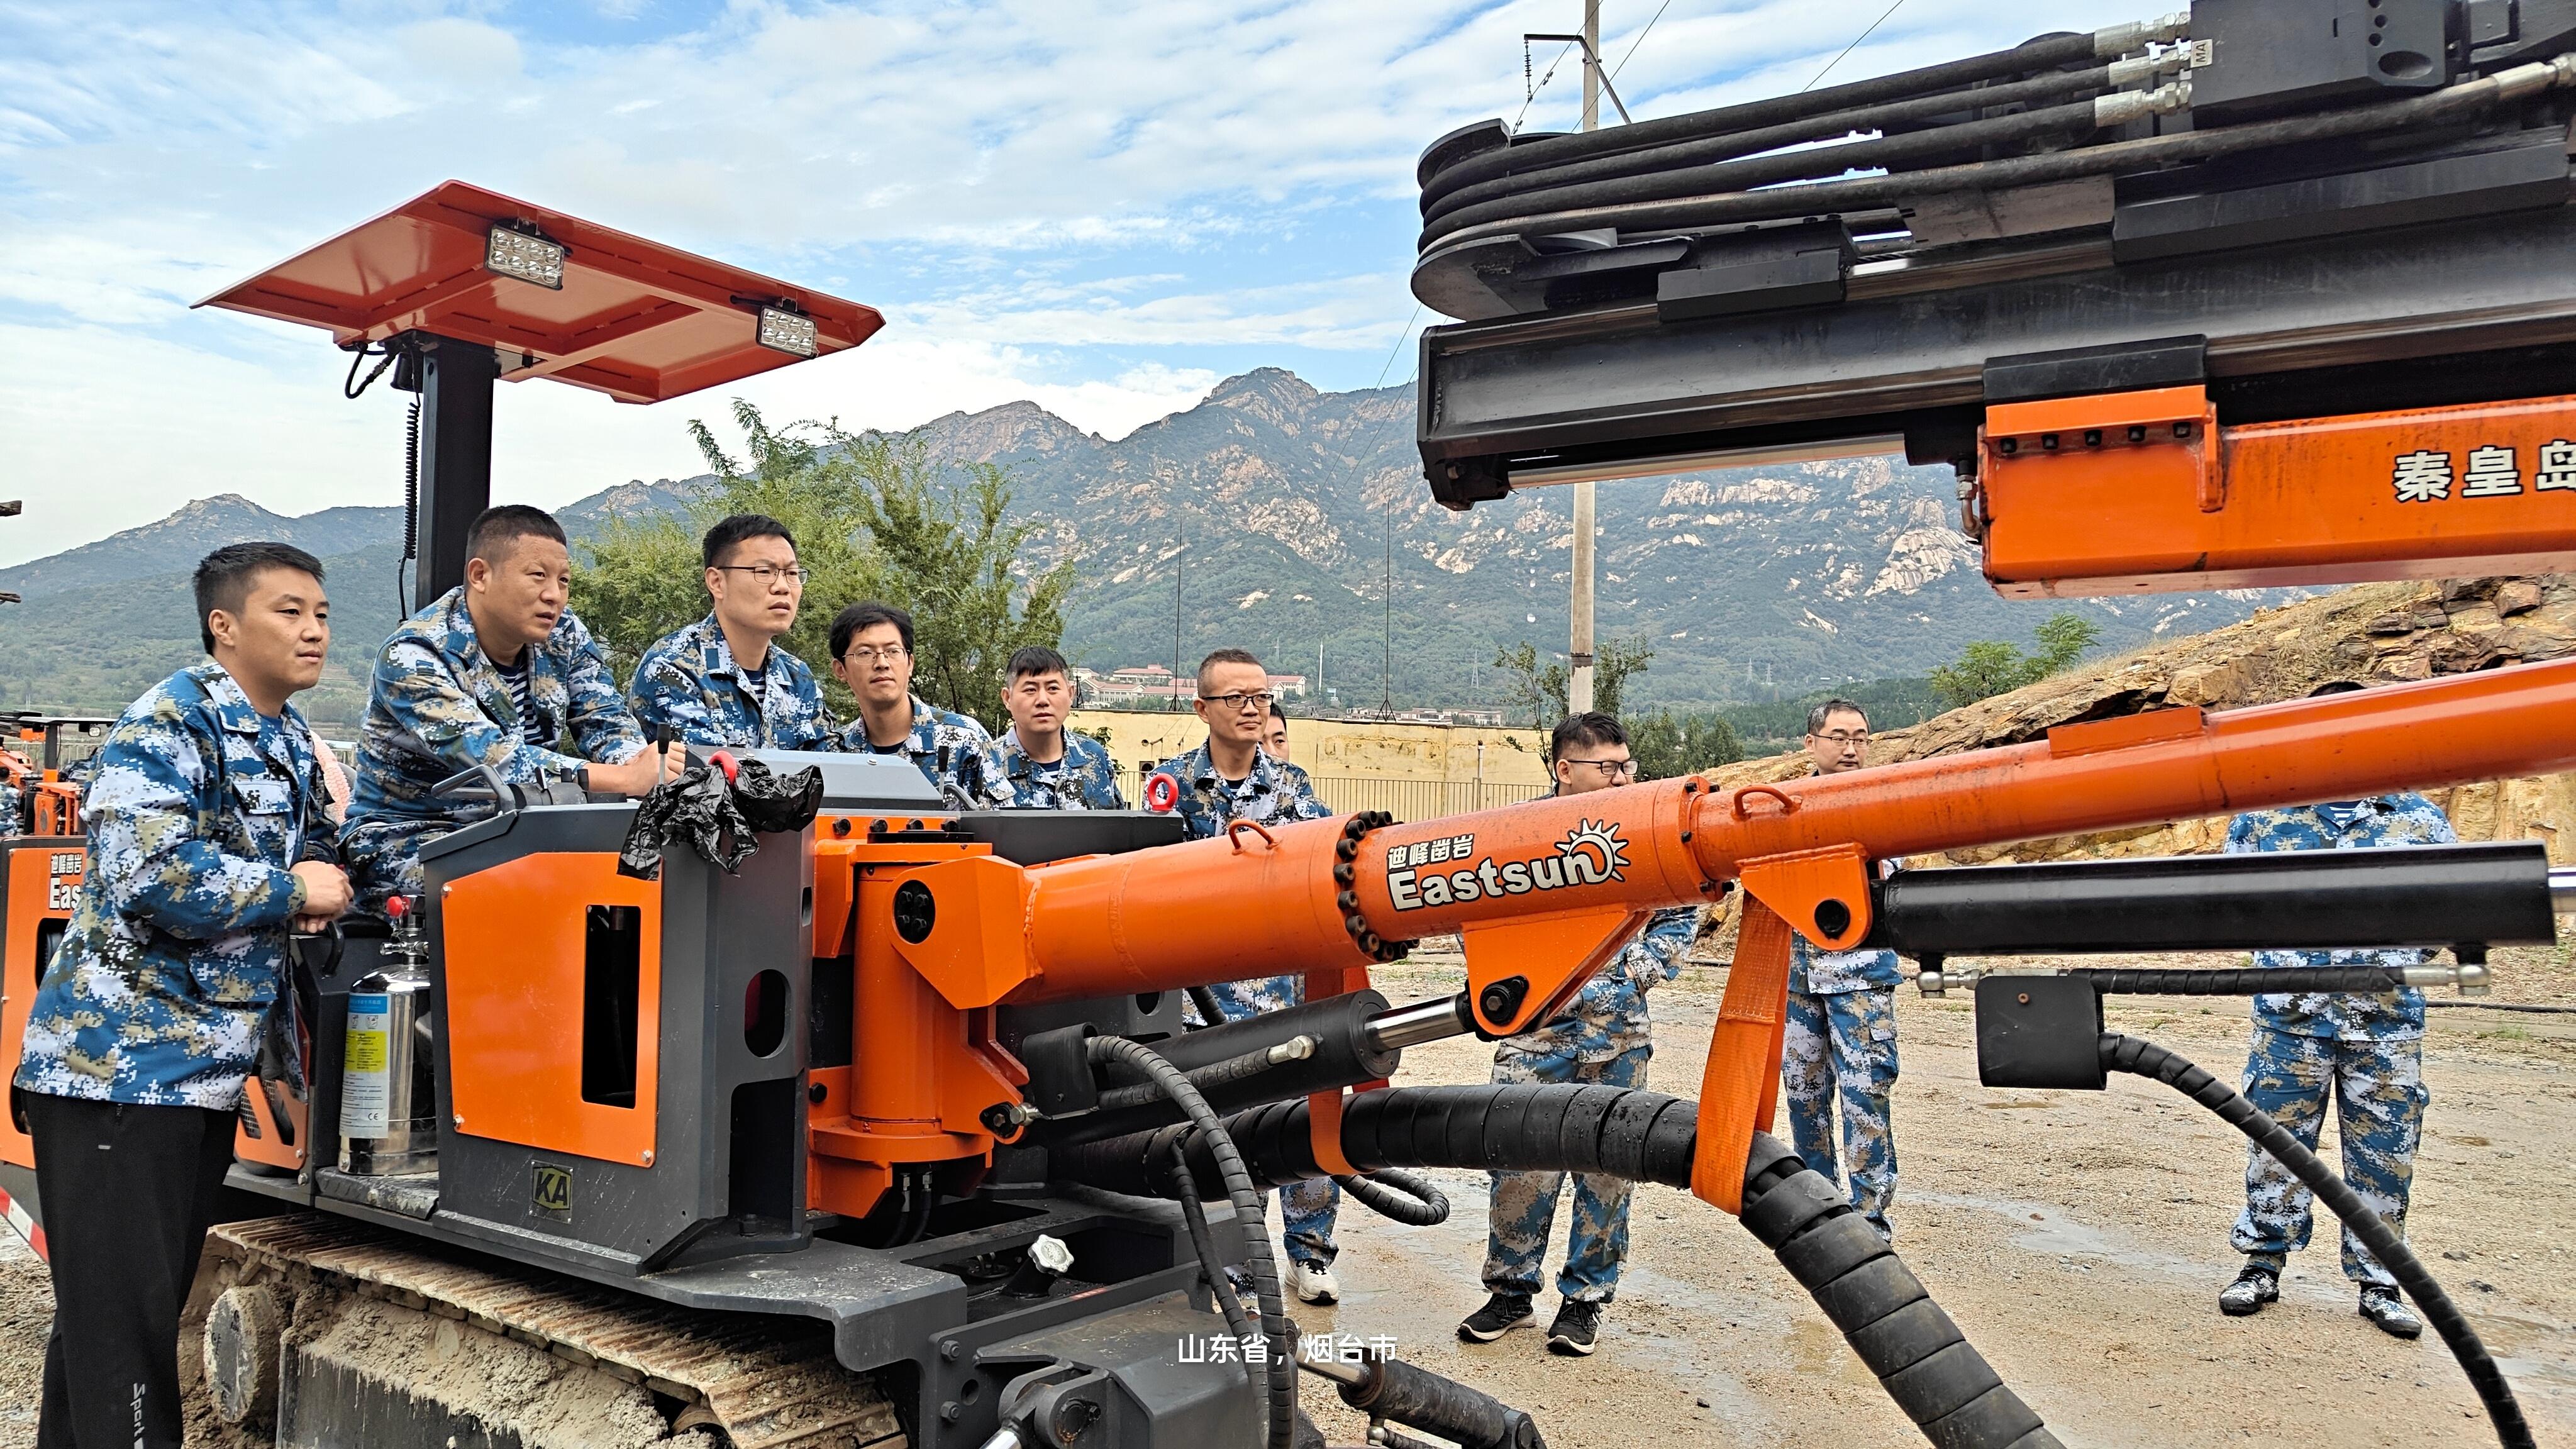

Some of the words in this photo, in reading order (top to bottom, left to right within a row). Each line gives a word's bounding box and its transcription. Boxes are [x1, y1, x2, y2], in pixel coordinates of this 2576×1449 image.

[2392, 439, 2576, 502] 秦皇岛
[1387, 833, 1475, 870] 迪峰凿岩
[1387, 846, 1605, 911] Eastsun
[535, 1171, 567, 1206] KA
